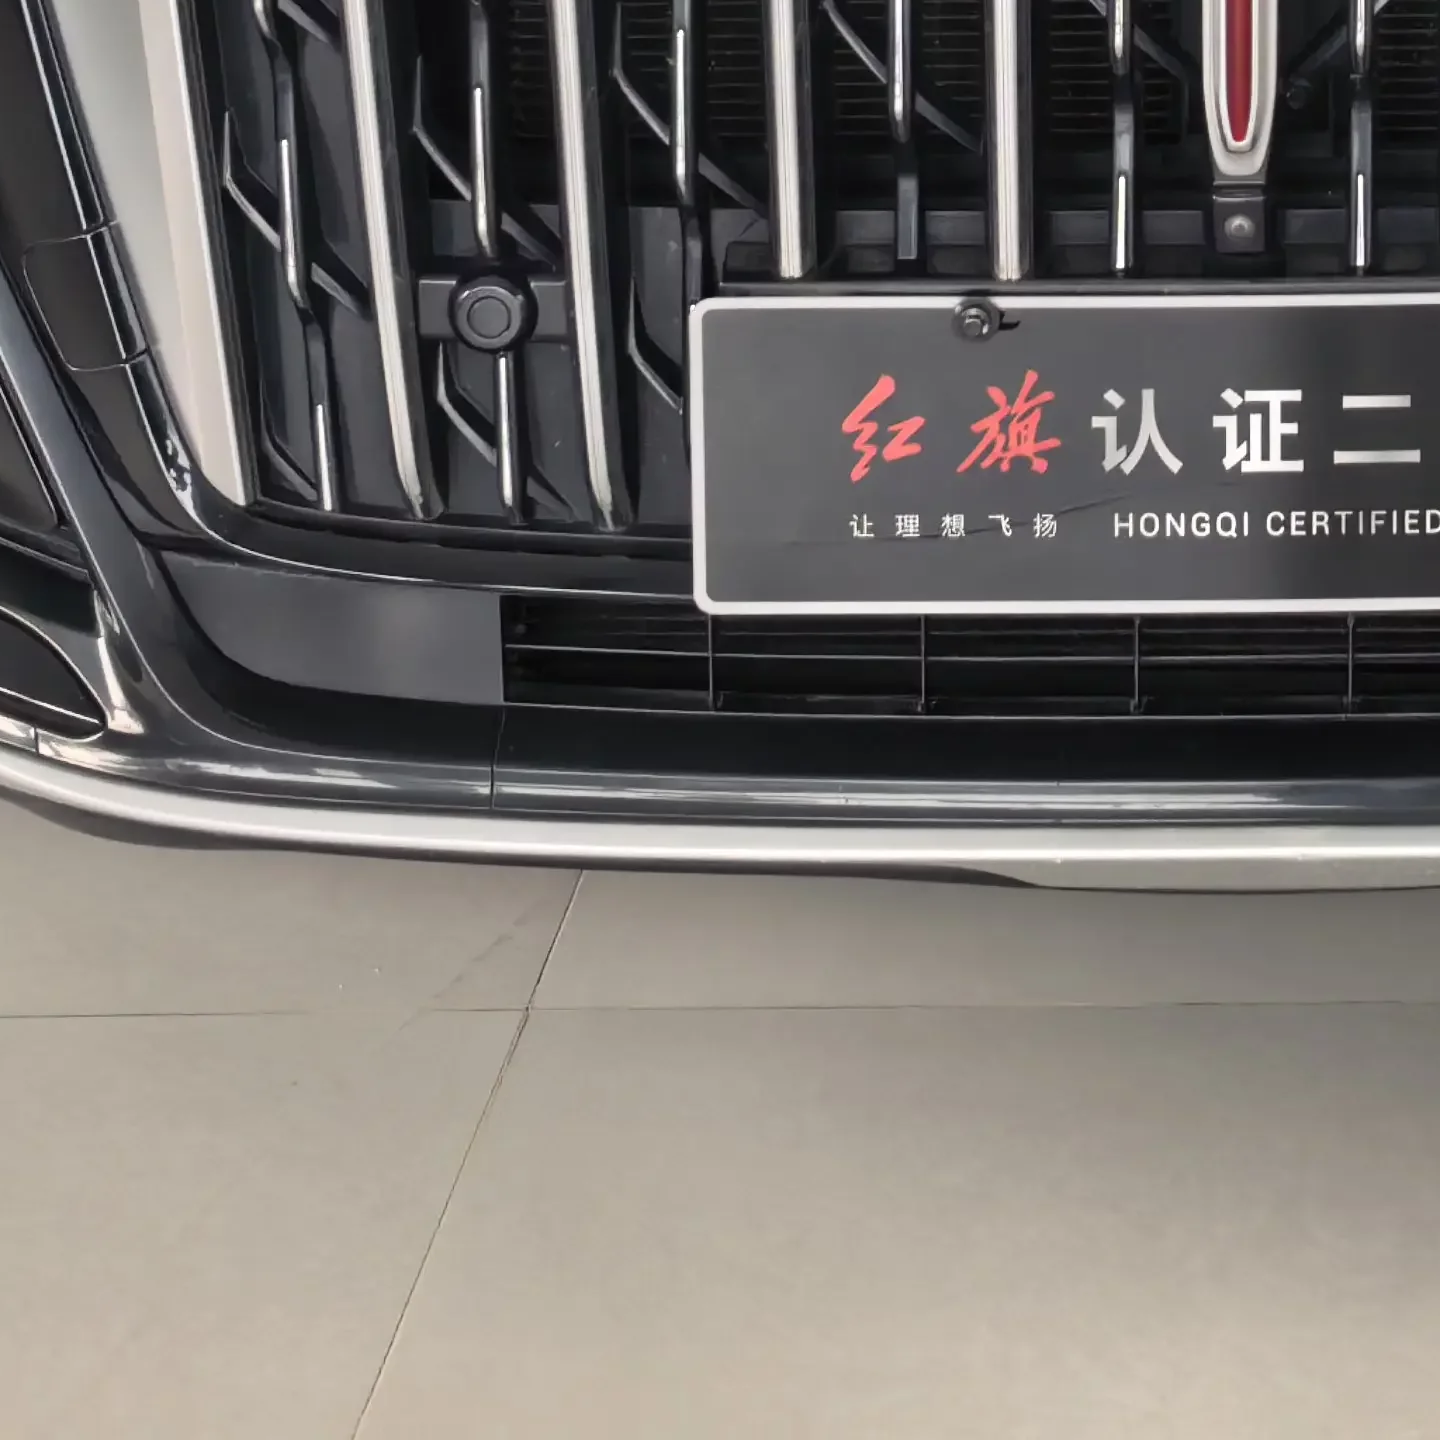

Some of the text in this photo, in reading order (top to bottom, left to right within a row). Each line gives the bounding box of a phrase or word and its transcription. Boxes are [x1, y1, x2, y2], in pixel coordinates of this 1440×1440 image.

[848, 512, 1057, 539] 让理想飞扬
[1113, 510, 1250, 539] HONGQI
